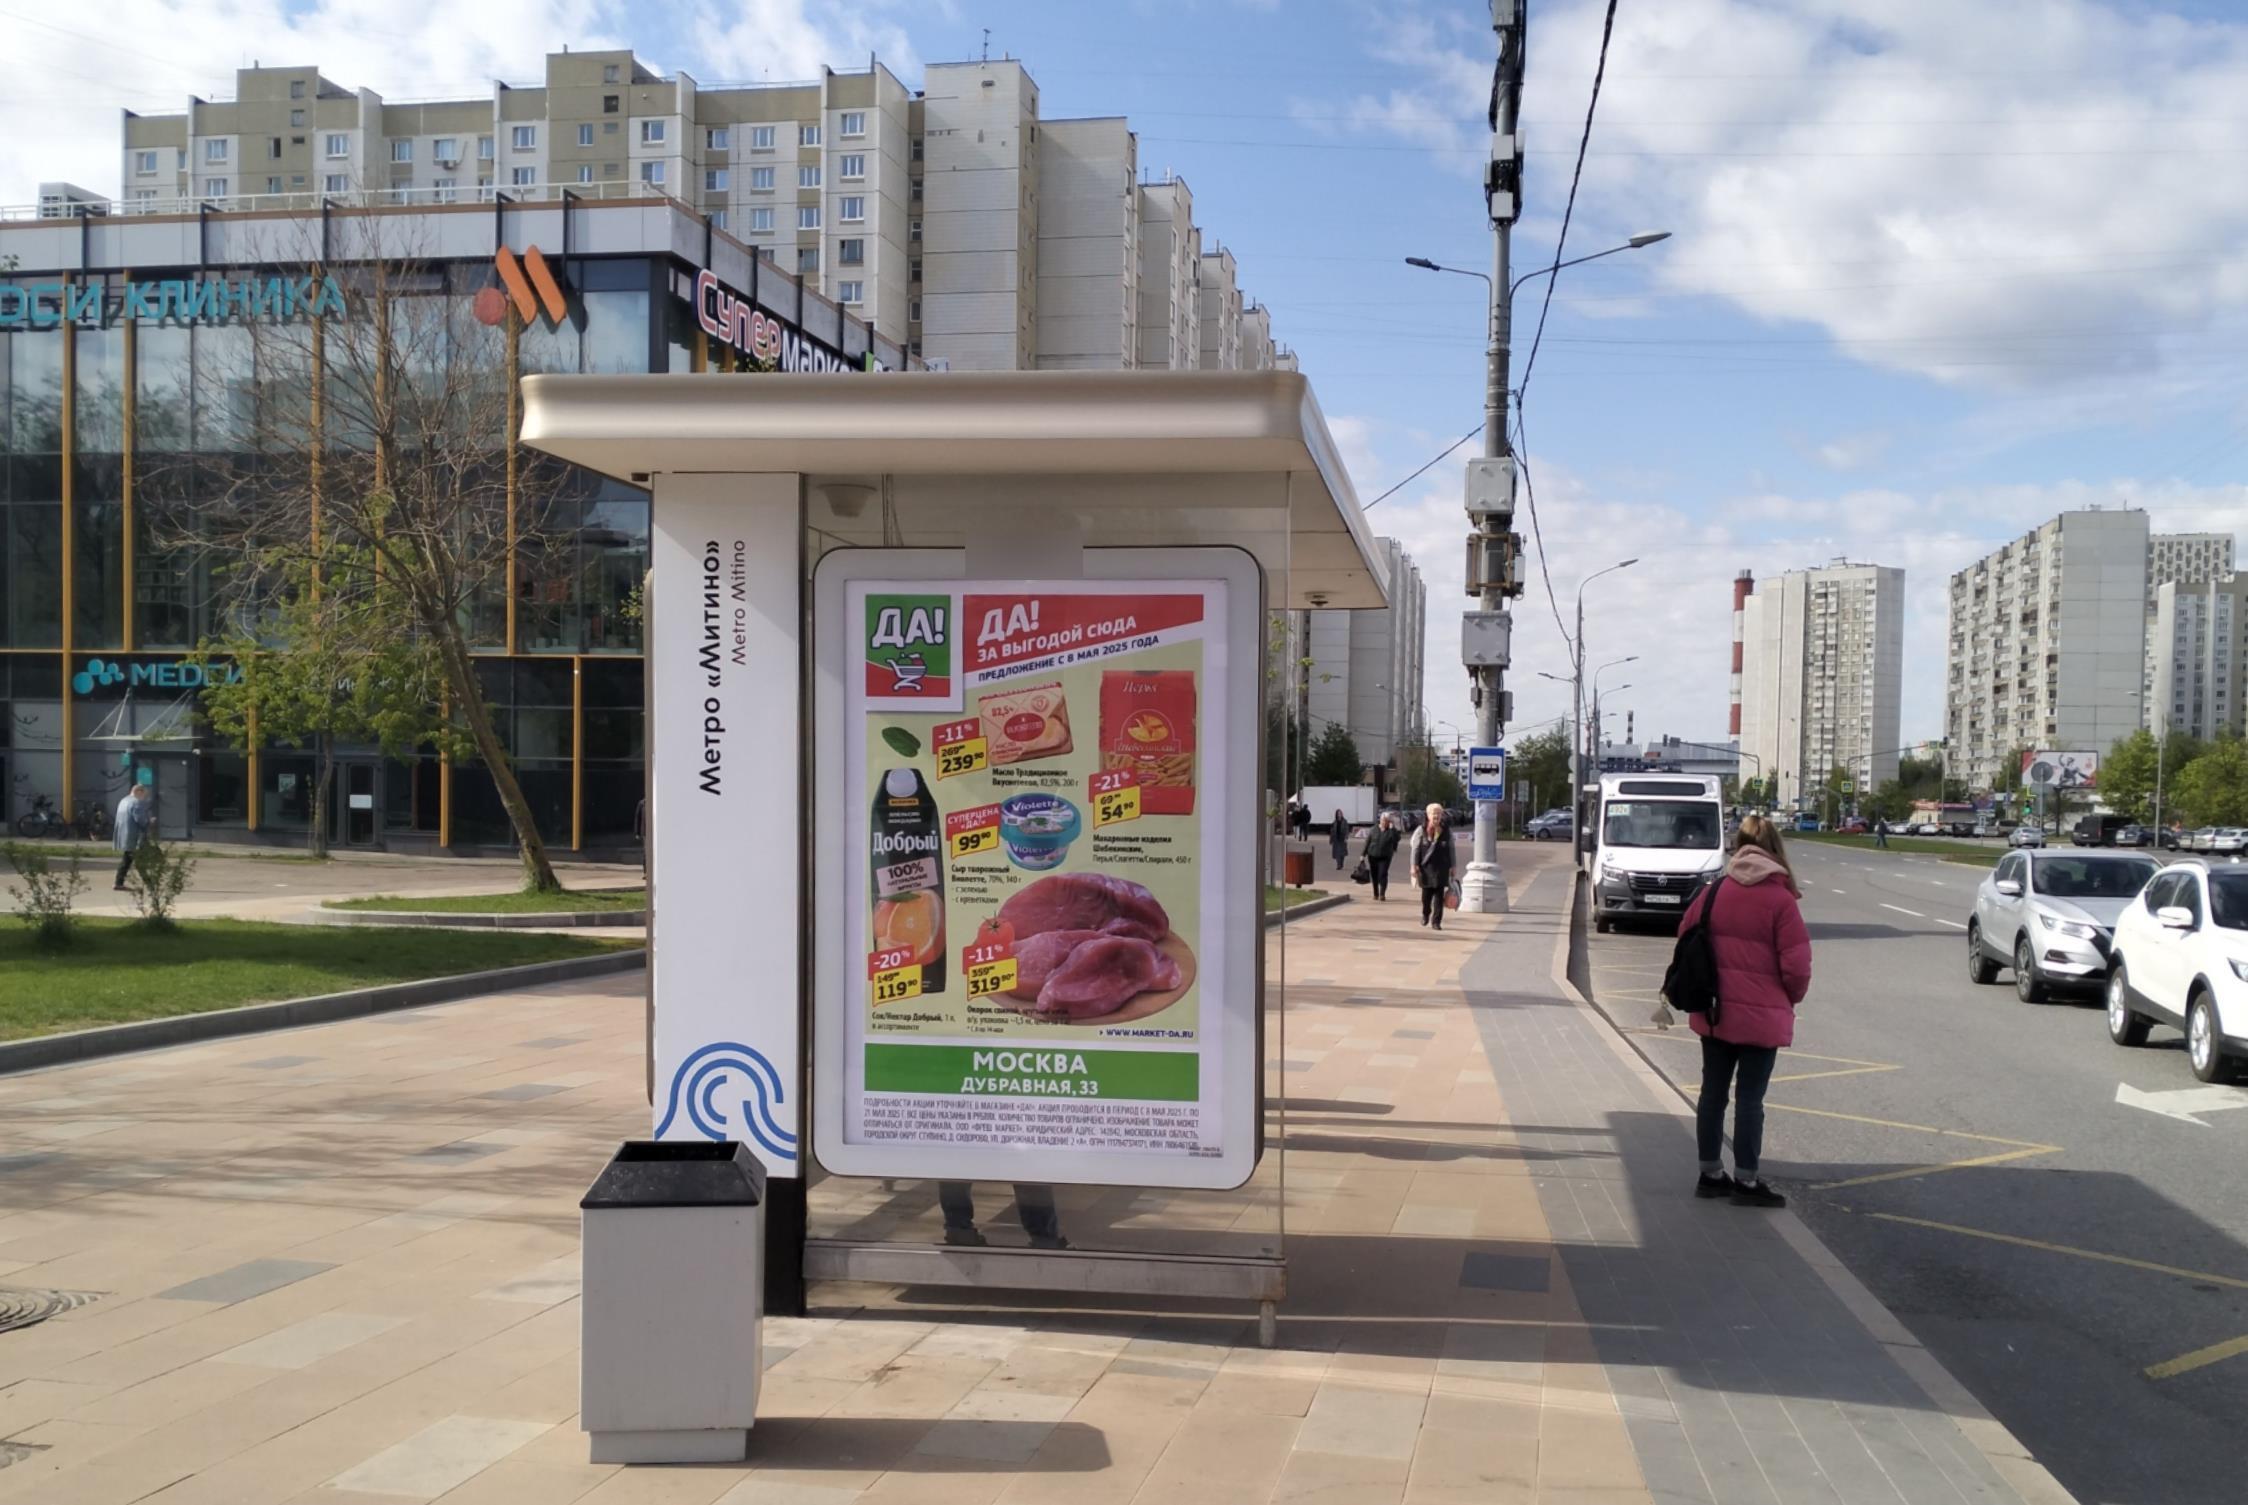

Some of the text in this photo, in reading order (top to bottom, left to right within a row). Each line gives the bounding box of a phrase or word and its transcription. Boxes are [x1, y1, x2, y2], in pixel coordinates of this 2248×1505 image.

[126, 275, 346, 321] КЛИНИКА
[731, 540, 746, 666] Metro Mitino
[872, 607, 945, 648] ДА!
[977, 601, 1039, 646] ДА!
[977, 616, 1137, 663] ЗА ВЫГОДОЙ СЮДА
[699, 540, 725, 796] Метро «Митино»
[978, 635, 1160, 682] ПРЕДЛОЖЕНИЕ С 8 МАЯ 2025 ГОДА
[992, 768, 1015, 777] Масло
[1012, 799, 1060, 812] Violette
[947, 807, 1000, 825] СУПЕРЦЕНА
[872, 830, 939, 856] Добрый
[888, 861, 925, 879] 100%
[951, 864, 1010, 875] Сыр творожный
[912, 1013, 943, 1022] Добрый,
[967, 1005, 992, 1014] Окорок
[1107, 1029, 1194, 1038] WWW.MARKET-DA.RU
[973, 1052, 1089, 1075] МОСКВА
[960, 1076, 1099, 1096] ДУБРАВНАЯ, 33
[981, 1102, 1015, 1111] МАГАЗИНЕ
[1062, 1104, 1104, 1114] ПРОВОДИТСЯ
[1112, 1106, 1139, 1115] ПЕРИОД
